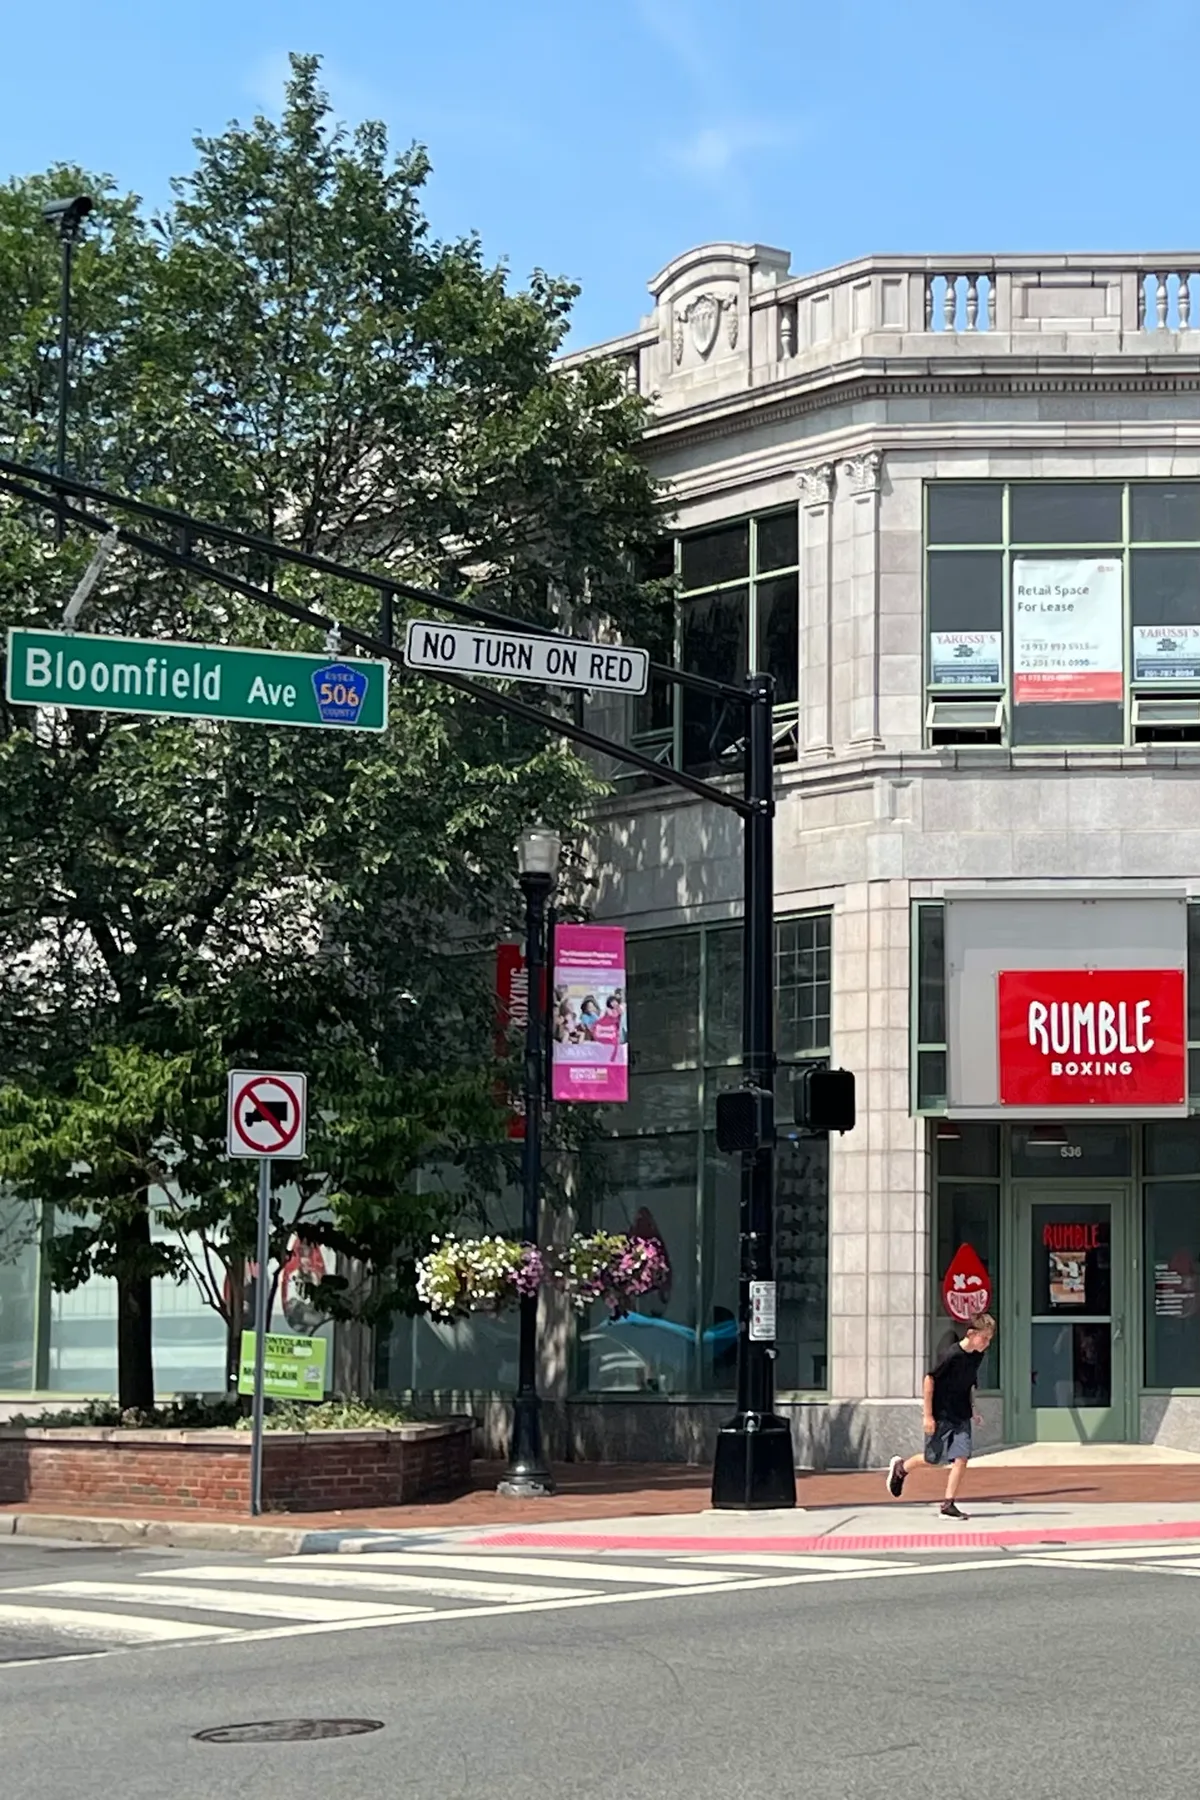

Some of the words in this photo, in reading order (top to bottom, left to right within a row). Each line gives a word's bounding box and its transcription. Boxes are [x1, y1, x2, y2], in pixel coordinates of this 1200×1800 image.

[1017, 585, 1051, 596] Retail
[1055, 585, 1090, 598] Space
[1017, 602, 1037, 612] For
[1040, 602, 1075, 612] Lease
[423, 631, 457, 662] NO
[473, 639, 533, 672] TURN
[547, 647, 577, 676] ON
[590, 652, 634, 684] RED
[25, 646, 222, 702] Bloomfield
[247, 674, 297, 709] Ave
[320, 683, 360, 707] 506
[1028, 1000, 1155, 1056] RUMBLE
[1051, 1061, 1133, 1076] BOXING
[1060, 1146, 1082, 1158] 536
[1043, 1222, 1101, 1251] RUMBLE
[264, 1337, 313, 1348] ONTCLAIR
